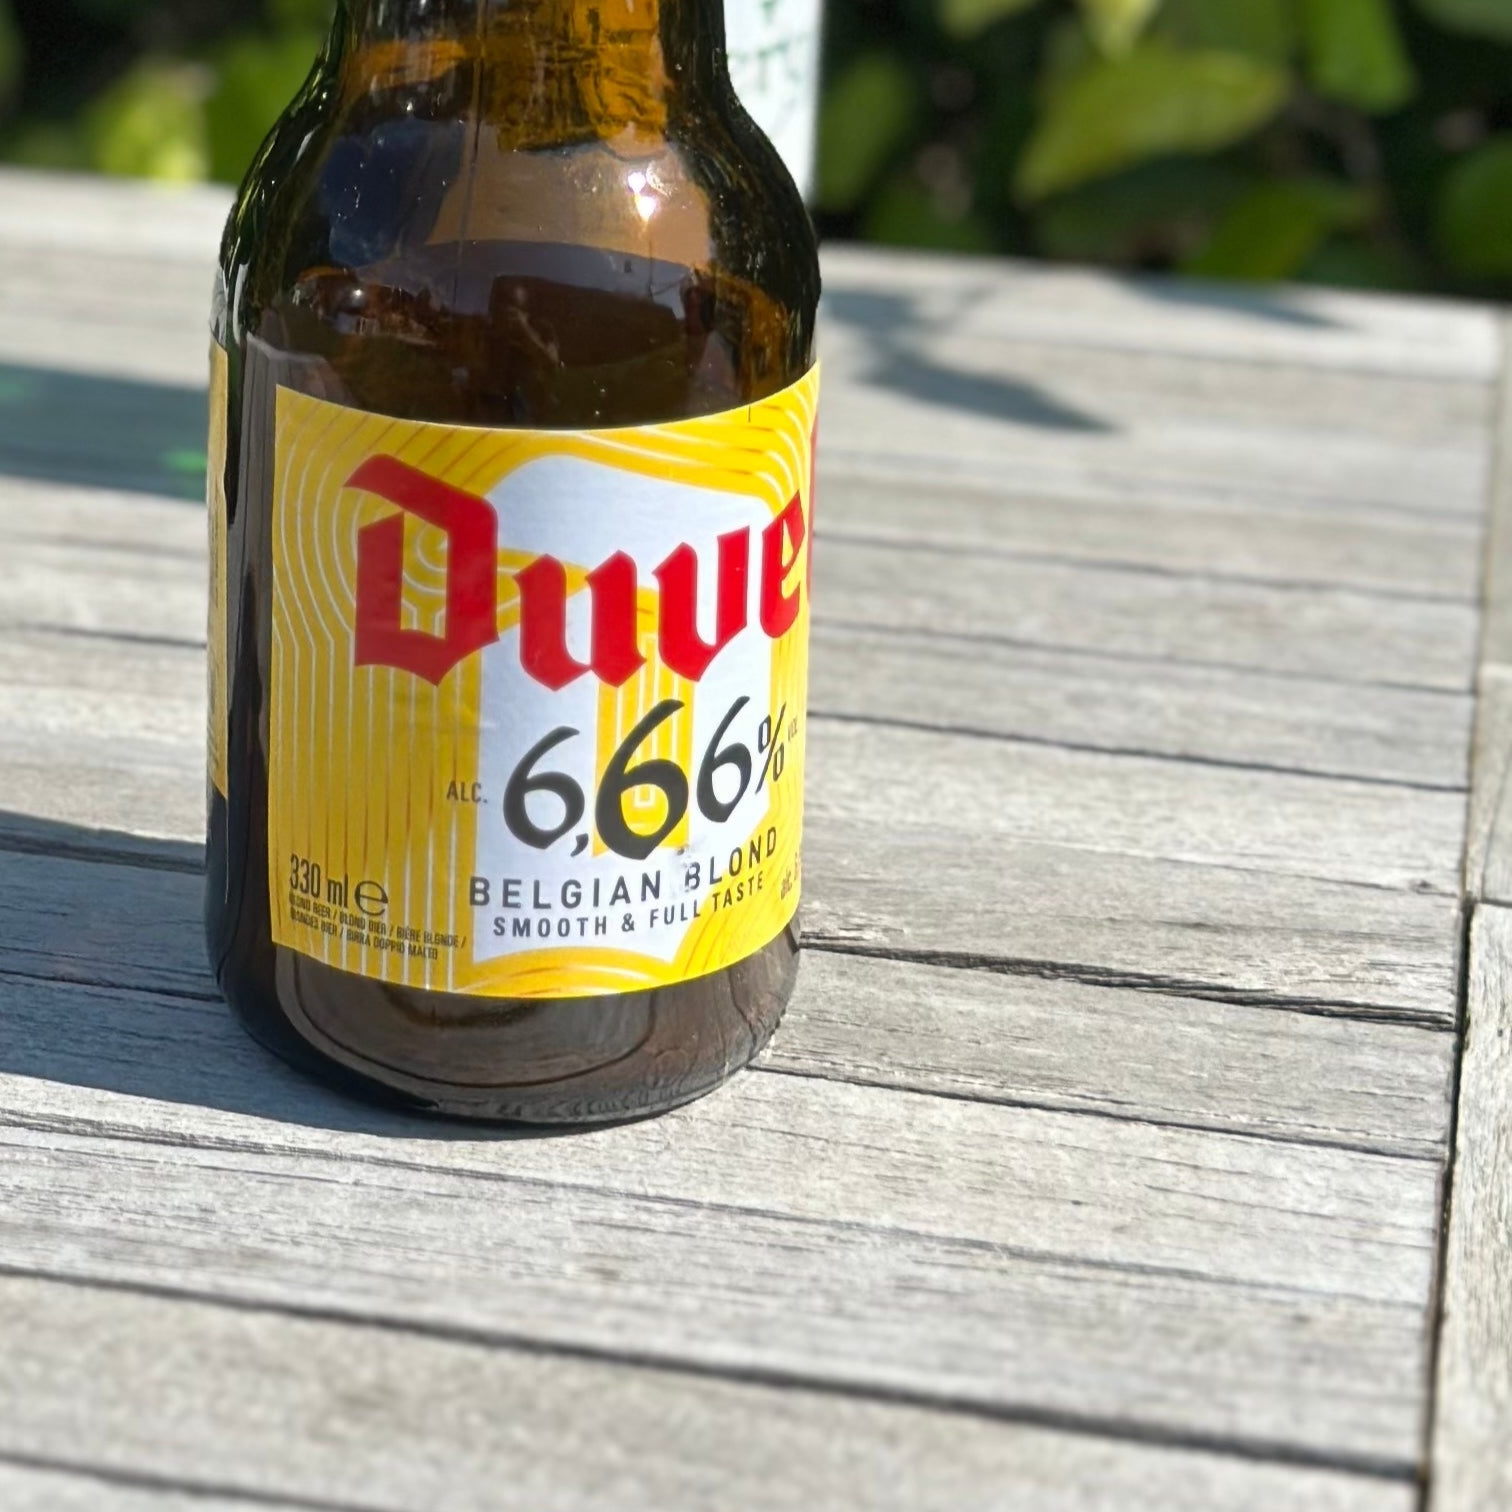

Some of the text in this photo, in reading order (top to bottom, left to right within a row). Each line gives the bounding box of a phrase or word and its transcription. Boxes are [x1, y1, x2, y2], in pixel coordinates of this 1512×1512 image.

[446, 779, 488, 804] ALC.
[502, 695, 787, 861] 6,66%
[289, 853, 321, 899] 330
[327, 873, 349, 909] ml
[469, 870, 661, 910] BELGIAN
[683, 826, 778, 893] BLOND
[493, 915, 608, 938] SMOOTH
[621, 913, 636, 933] &
[649, 899, 702, 929] FULL
[711, 870, 765, 913] TASTE
